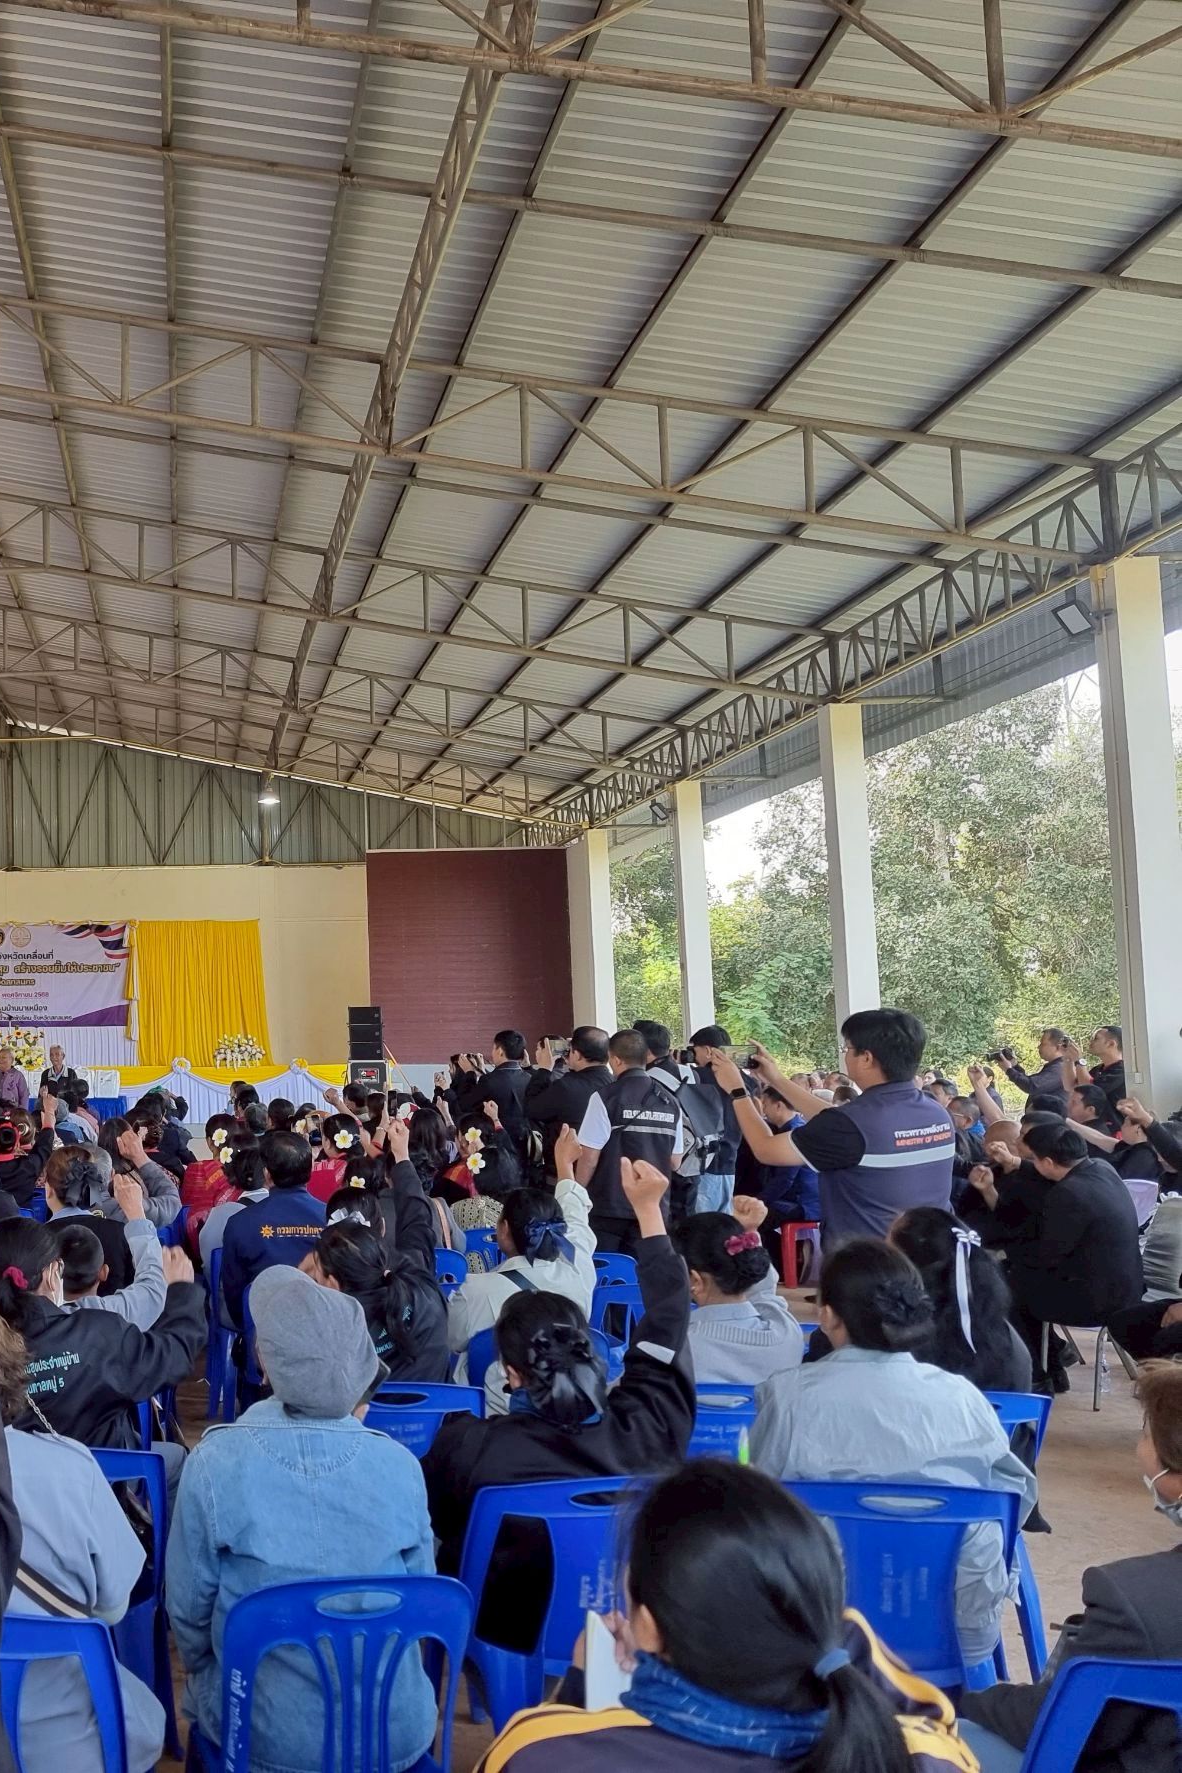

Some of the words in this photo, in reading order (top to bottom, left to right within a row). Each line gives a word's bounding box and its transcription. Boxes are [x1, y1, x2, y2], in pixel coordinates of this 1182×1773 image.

[0, 1004, 47, 1012] นบ้านนาเหมือง
[894, 1123, 950, 1138] กระทรวงพลังงาน
[896, 1137, 924, 1147] MINISTRY
[925, 1136, 932, 1144] OF
[276, 1224, 324, 1235] กรมการปกคร
[58, 1377, 65, 1388] 5
